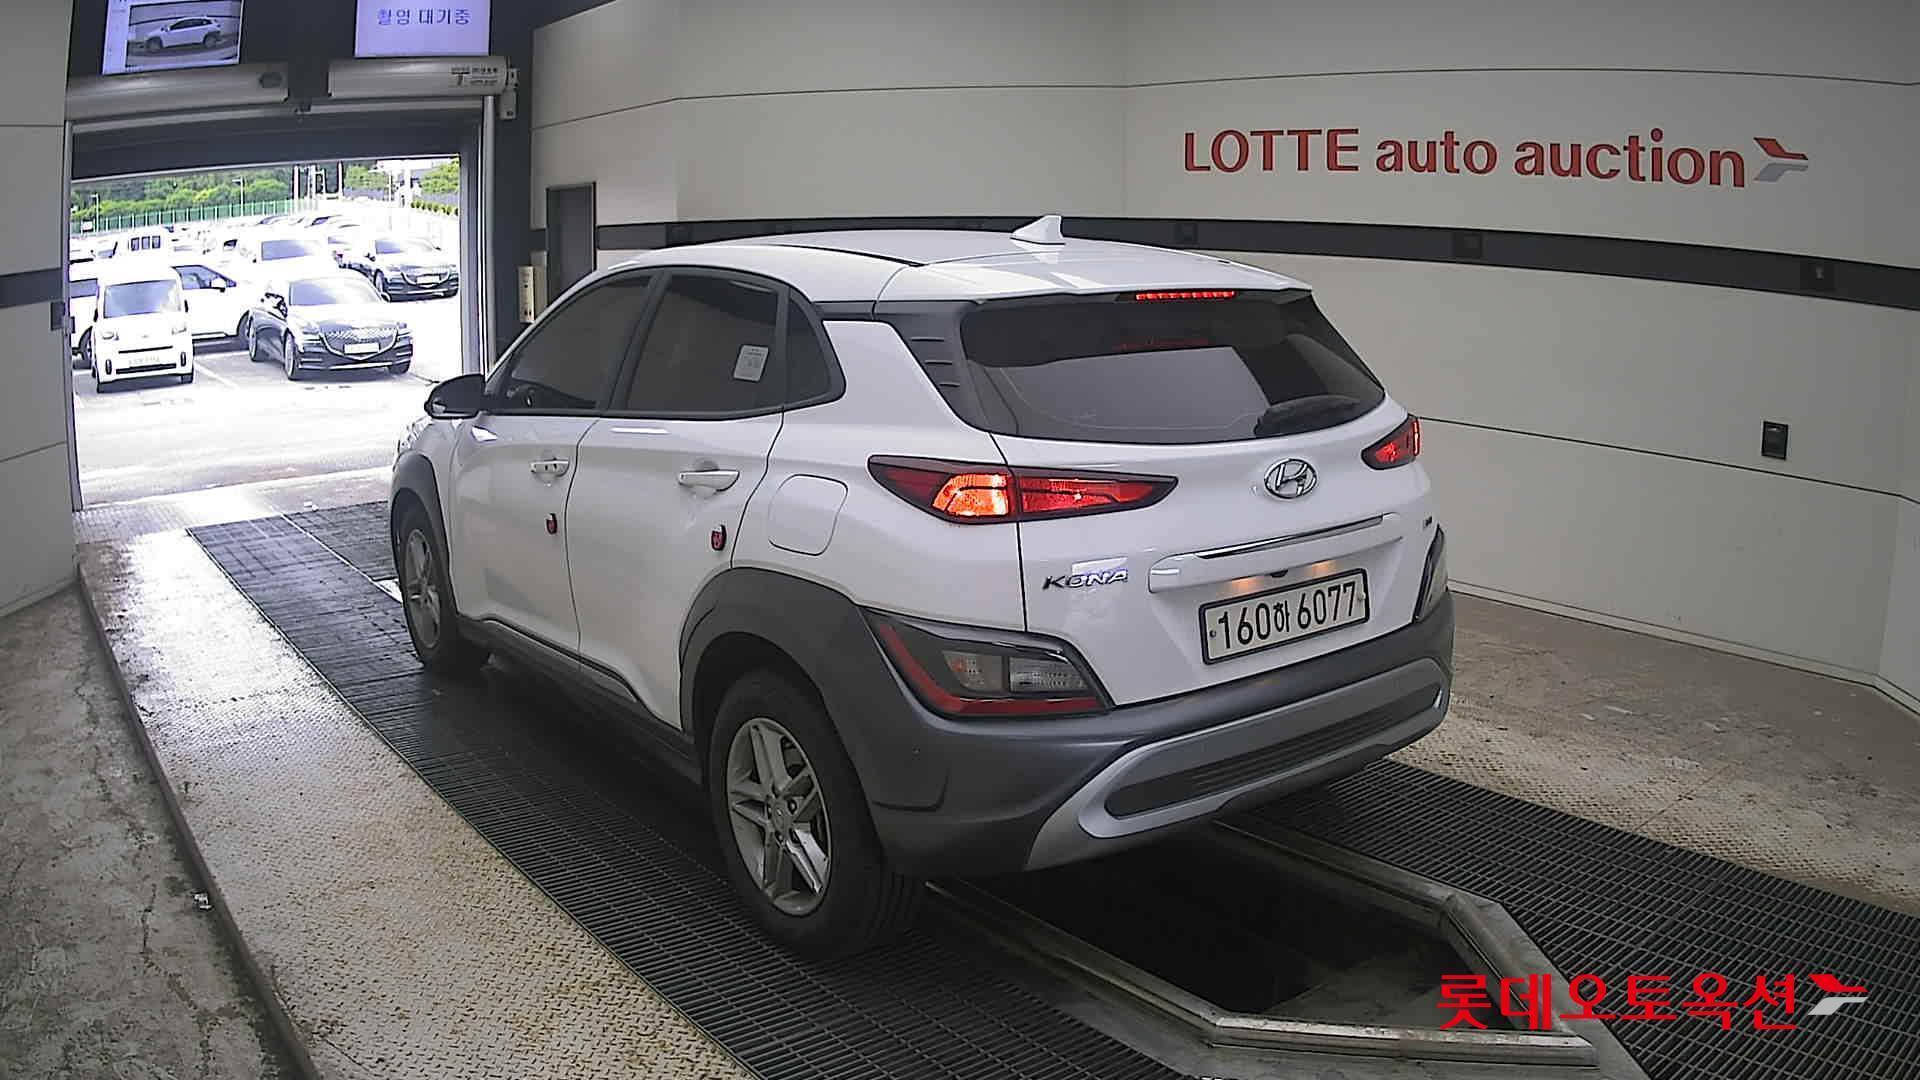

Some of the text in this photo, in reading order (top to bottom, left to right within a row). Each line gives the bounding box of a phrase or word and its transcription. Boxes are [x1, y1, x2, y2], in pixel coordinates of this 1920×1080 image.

[418, 8, 470, 26] 대기중
[1184, 128, 1746, 188] LOTTE auto auction
[1042, 568, 1129, 590] KONA
[1217, 581, 1358, 649] 160하 6077
